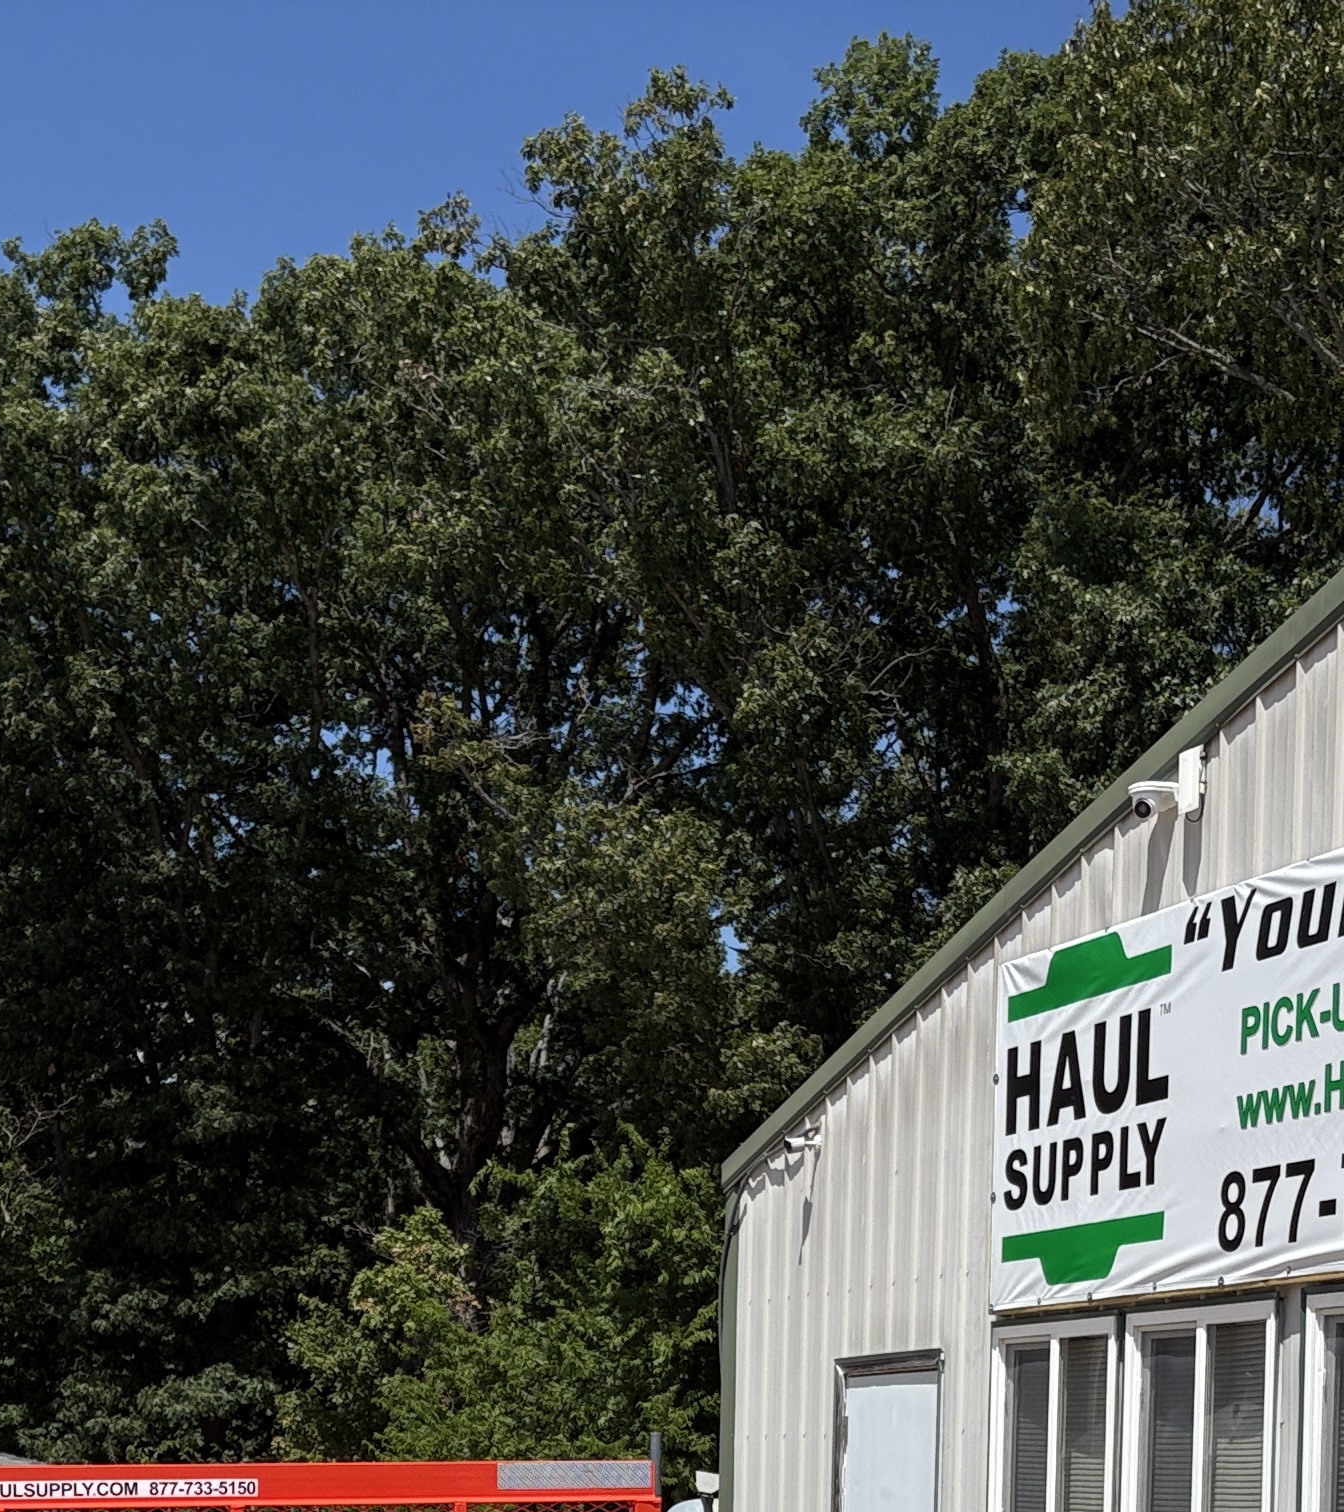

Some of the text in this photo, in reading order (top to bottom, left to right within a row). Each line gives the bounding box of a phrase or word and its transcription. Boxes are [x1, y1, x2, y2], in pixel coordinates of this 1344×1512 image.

[1006, 1009, 1168, 1135] HAUL
[1004, 1118, 1166, 1210] SUPPLY
[149, 1481, 256, 1496] 877-733-5150
